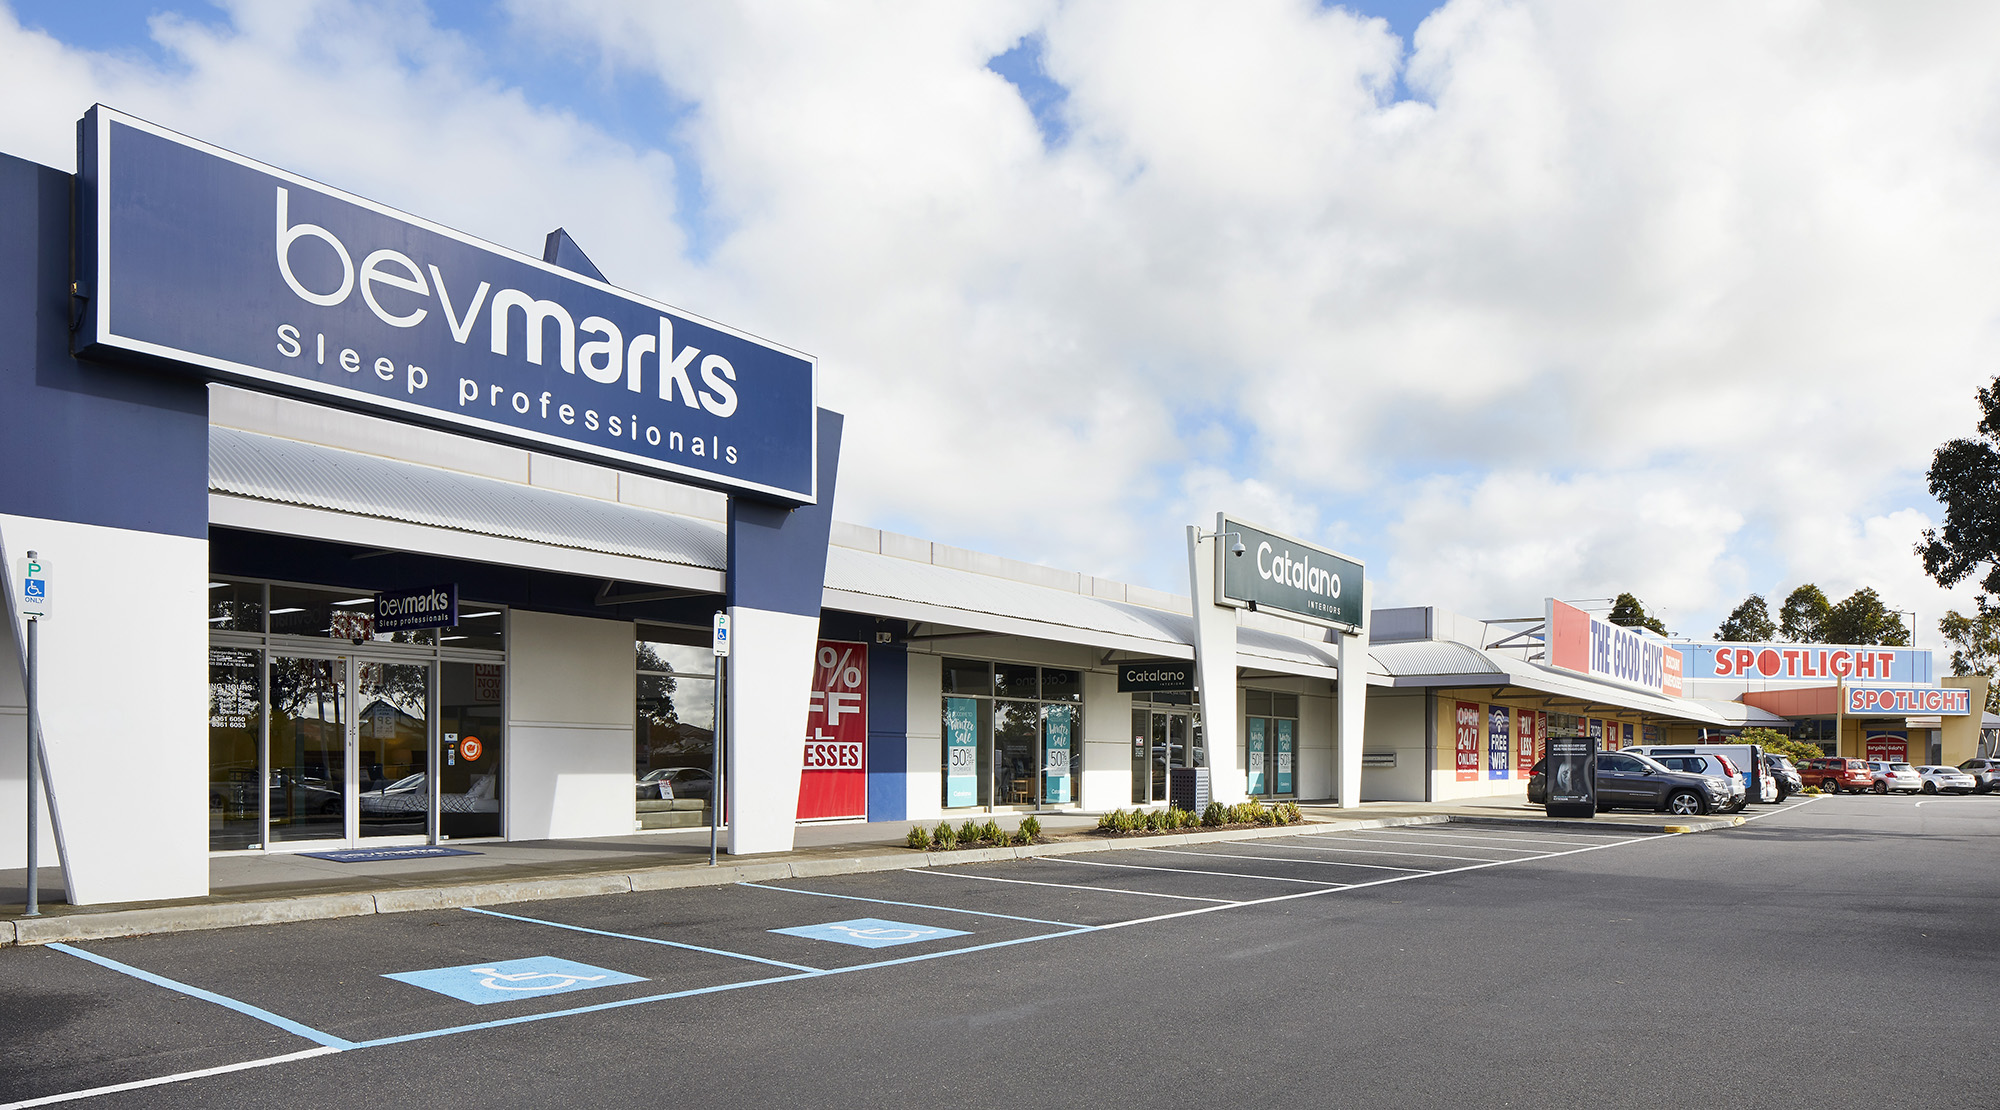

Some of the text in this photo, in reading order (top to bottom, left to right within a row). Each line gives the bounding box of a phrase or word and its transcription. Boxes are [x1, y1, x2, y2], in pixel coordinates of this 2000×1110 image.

[276, 186, 738, 418] bevmarks
[276, 323, 738, 465] Sleep professionals
[28, 562, 42, 577] P
[1257, 541, 1341, 599] Catalano
[24, 596, 45, 604] ONLY
[379, 588, 448, 616] bevmarks
[1307, 600, 1341, 616] INTERIORS
[379, 619, 398, 627] Sleep
[399, 613, 449, 627] professionals
[719, 617, 726, 627] P
[1591, 619, 1663, 689] THE GOOD GUYS
[1714, 647, 1895, 679] SPOTLIGHT
[1126, 670, 1185, 682] Catalano
[1851, 690, 1968, 711] SPOTLIGHT
[1458, 707, 1478, 726] OPEN
[1521, 715, 1531, 735] PAY
[1458, 727, 1478, 750] 24/7
[1491, 734, 1507, 750] FREE
[1520, 737, 1532, 756] LESS
[803, 744, 859, 767] ESSES
[1457, 752, 1478, 765] ONLINE
